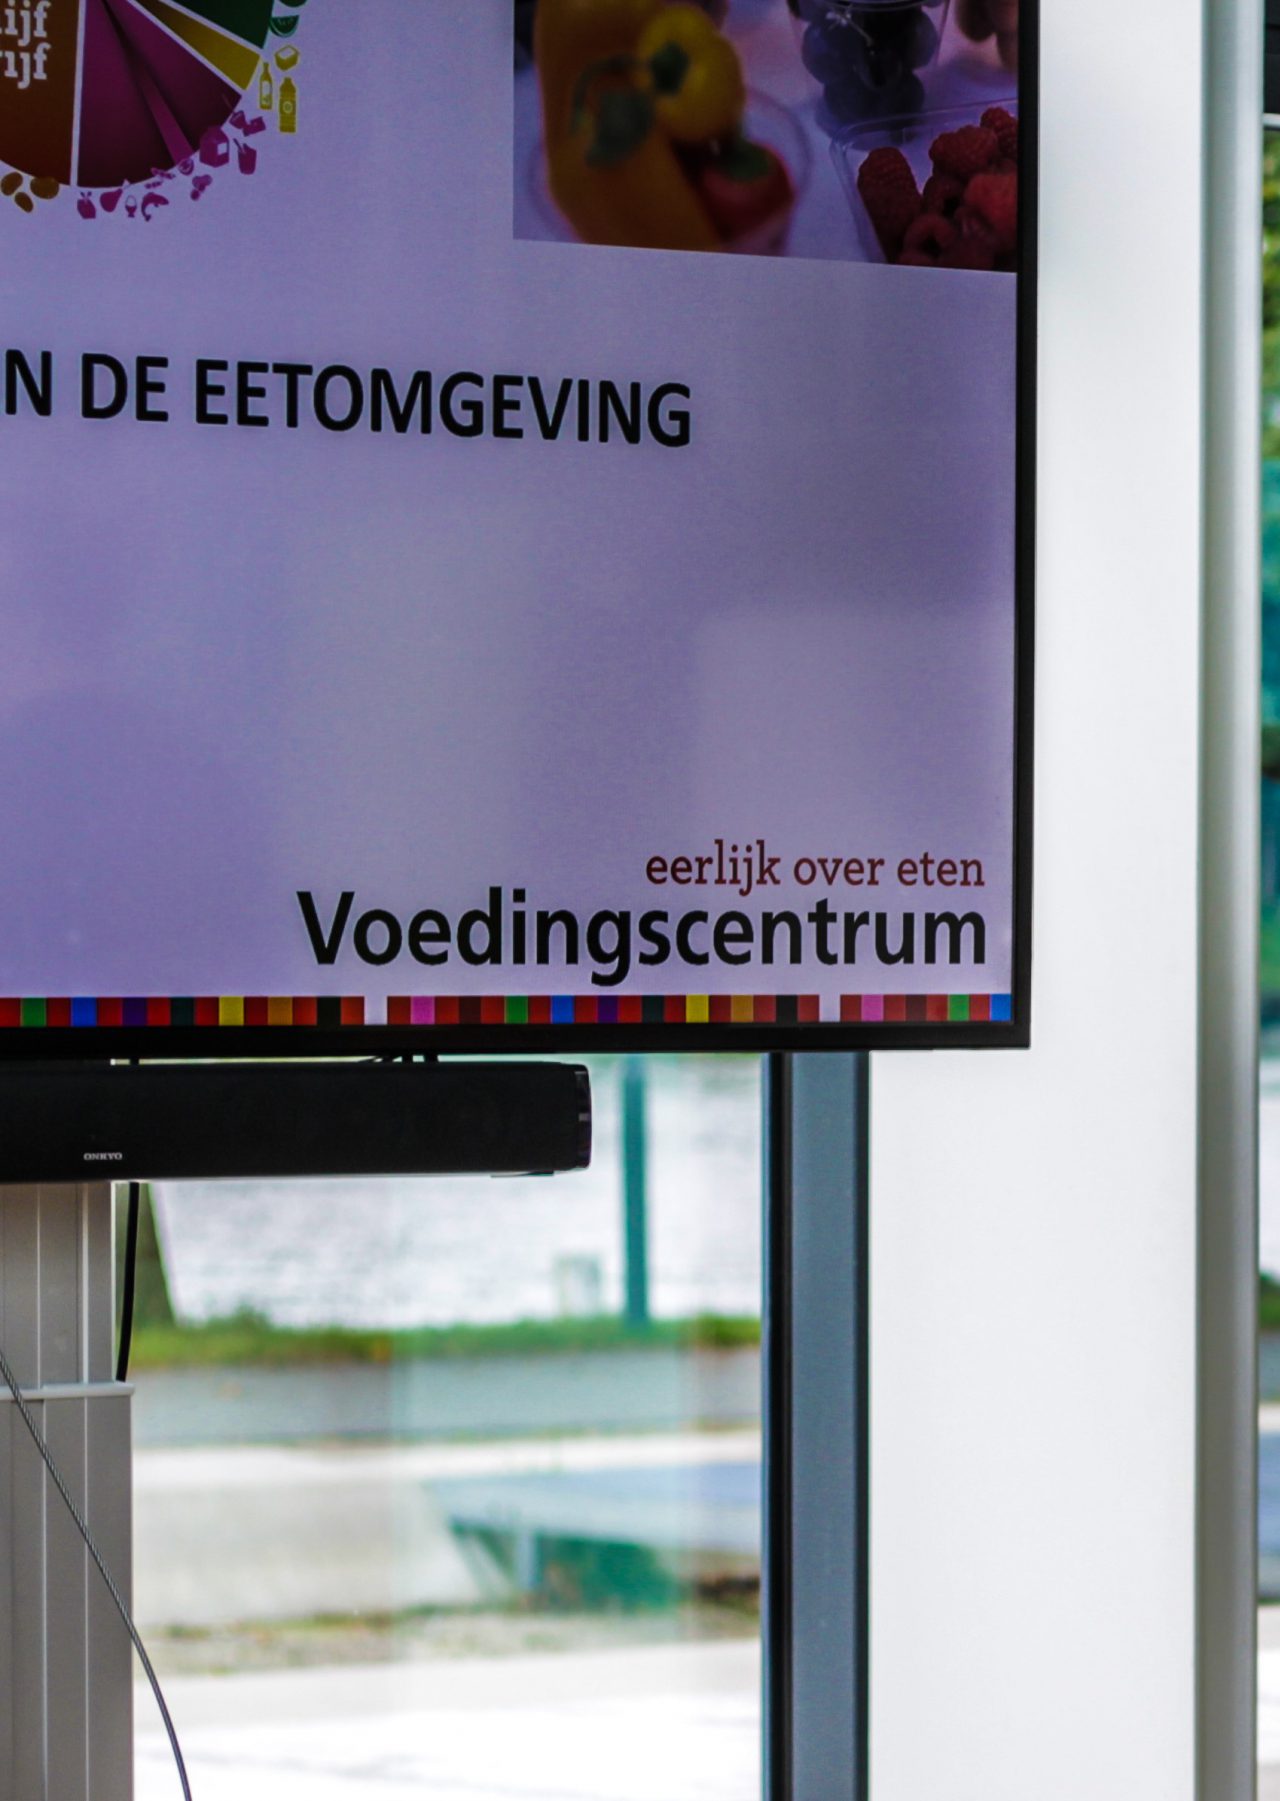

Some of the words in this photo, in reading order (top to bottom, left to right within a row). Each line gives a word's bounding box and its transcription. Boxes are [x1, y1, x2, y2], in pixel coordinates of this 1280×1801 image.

[0, 0, 52, 47] ijf
[0, 42, 52, 90] ijf
[81, 352, 169, 422] DE
[195, 358, 692, 448] EETOMGEVING
[645, 839, 781, 897] eerlijk
[793, 853, 886, 887] over
[897, 849, 986, 887] eten
[297, 886, 987, 988] Voedingscentrum
[83, 1152, 123, 1161] ONKYO
